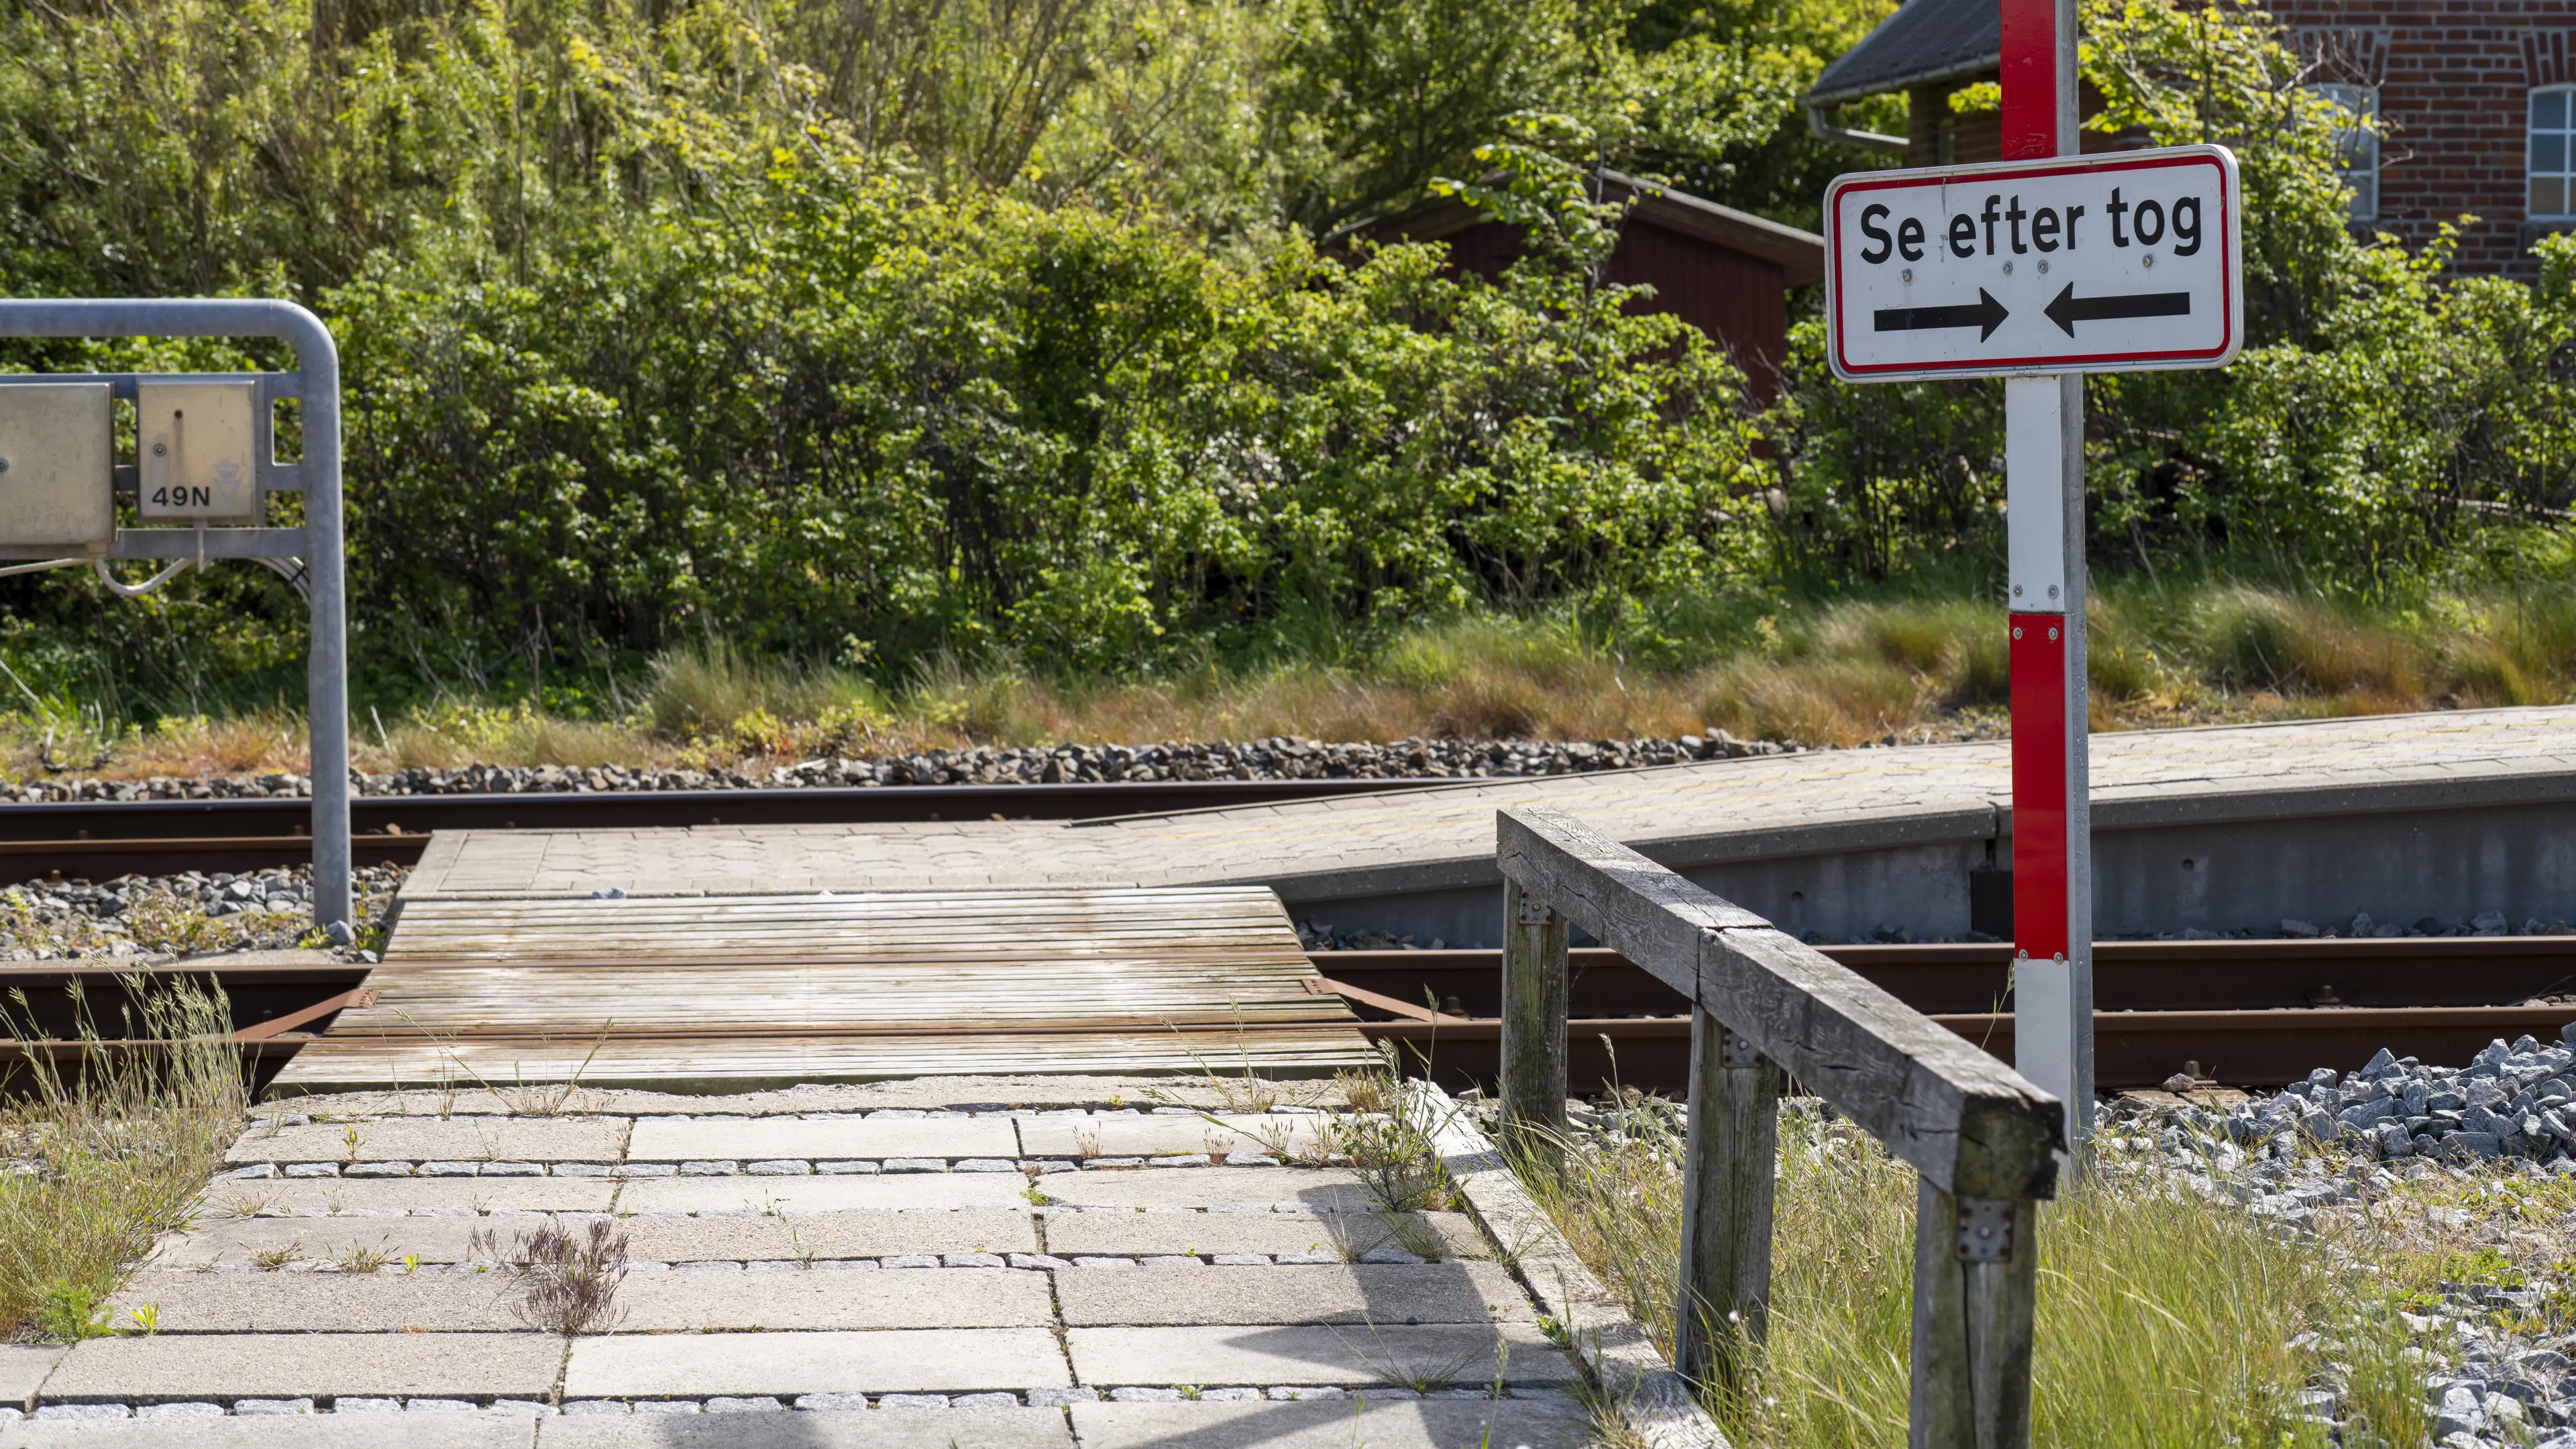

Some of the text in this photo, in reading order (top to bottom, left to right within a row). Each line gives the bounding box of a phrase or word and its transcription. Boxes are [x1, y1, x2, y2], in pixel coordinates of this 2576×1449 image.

[1860, 186, 2202, 264] Se efter tog
[152, 486, 210, 506] 49N
